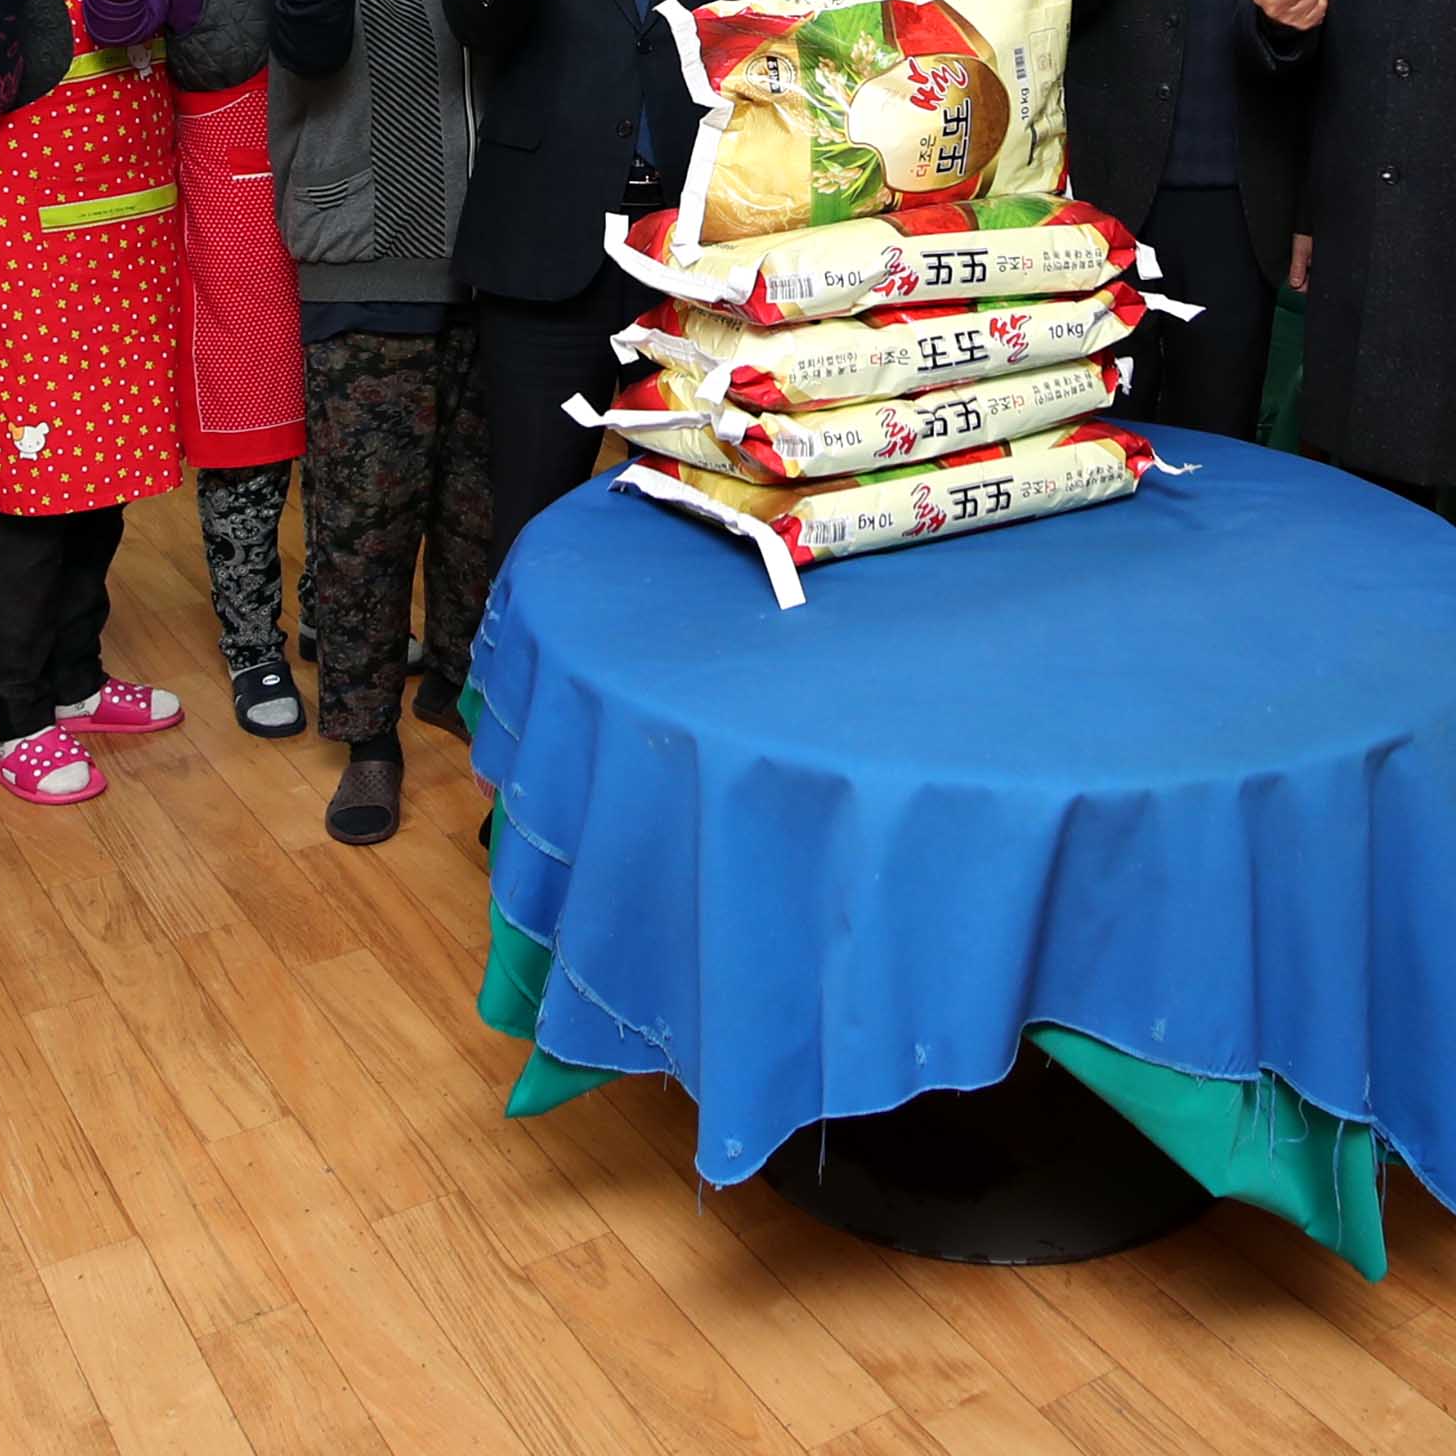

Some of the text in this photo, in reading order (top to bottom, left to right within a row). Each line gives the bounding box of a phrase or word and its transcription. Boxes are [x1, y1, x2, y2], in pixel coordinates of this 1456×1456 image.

[1048, 323, 1084, 340] 10 kg
[870, 348, 913, 368] 더조은
